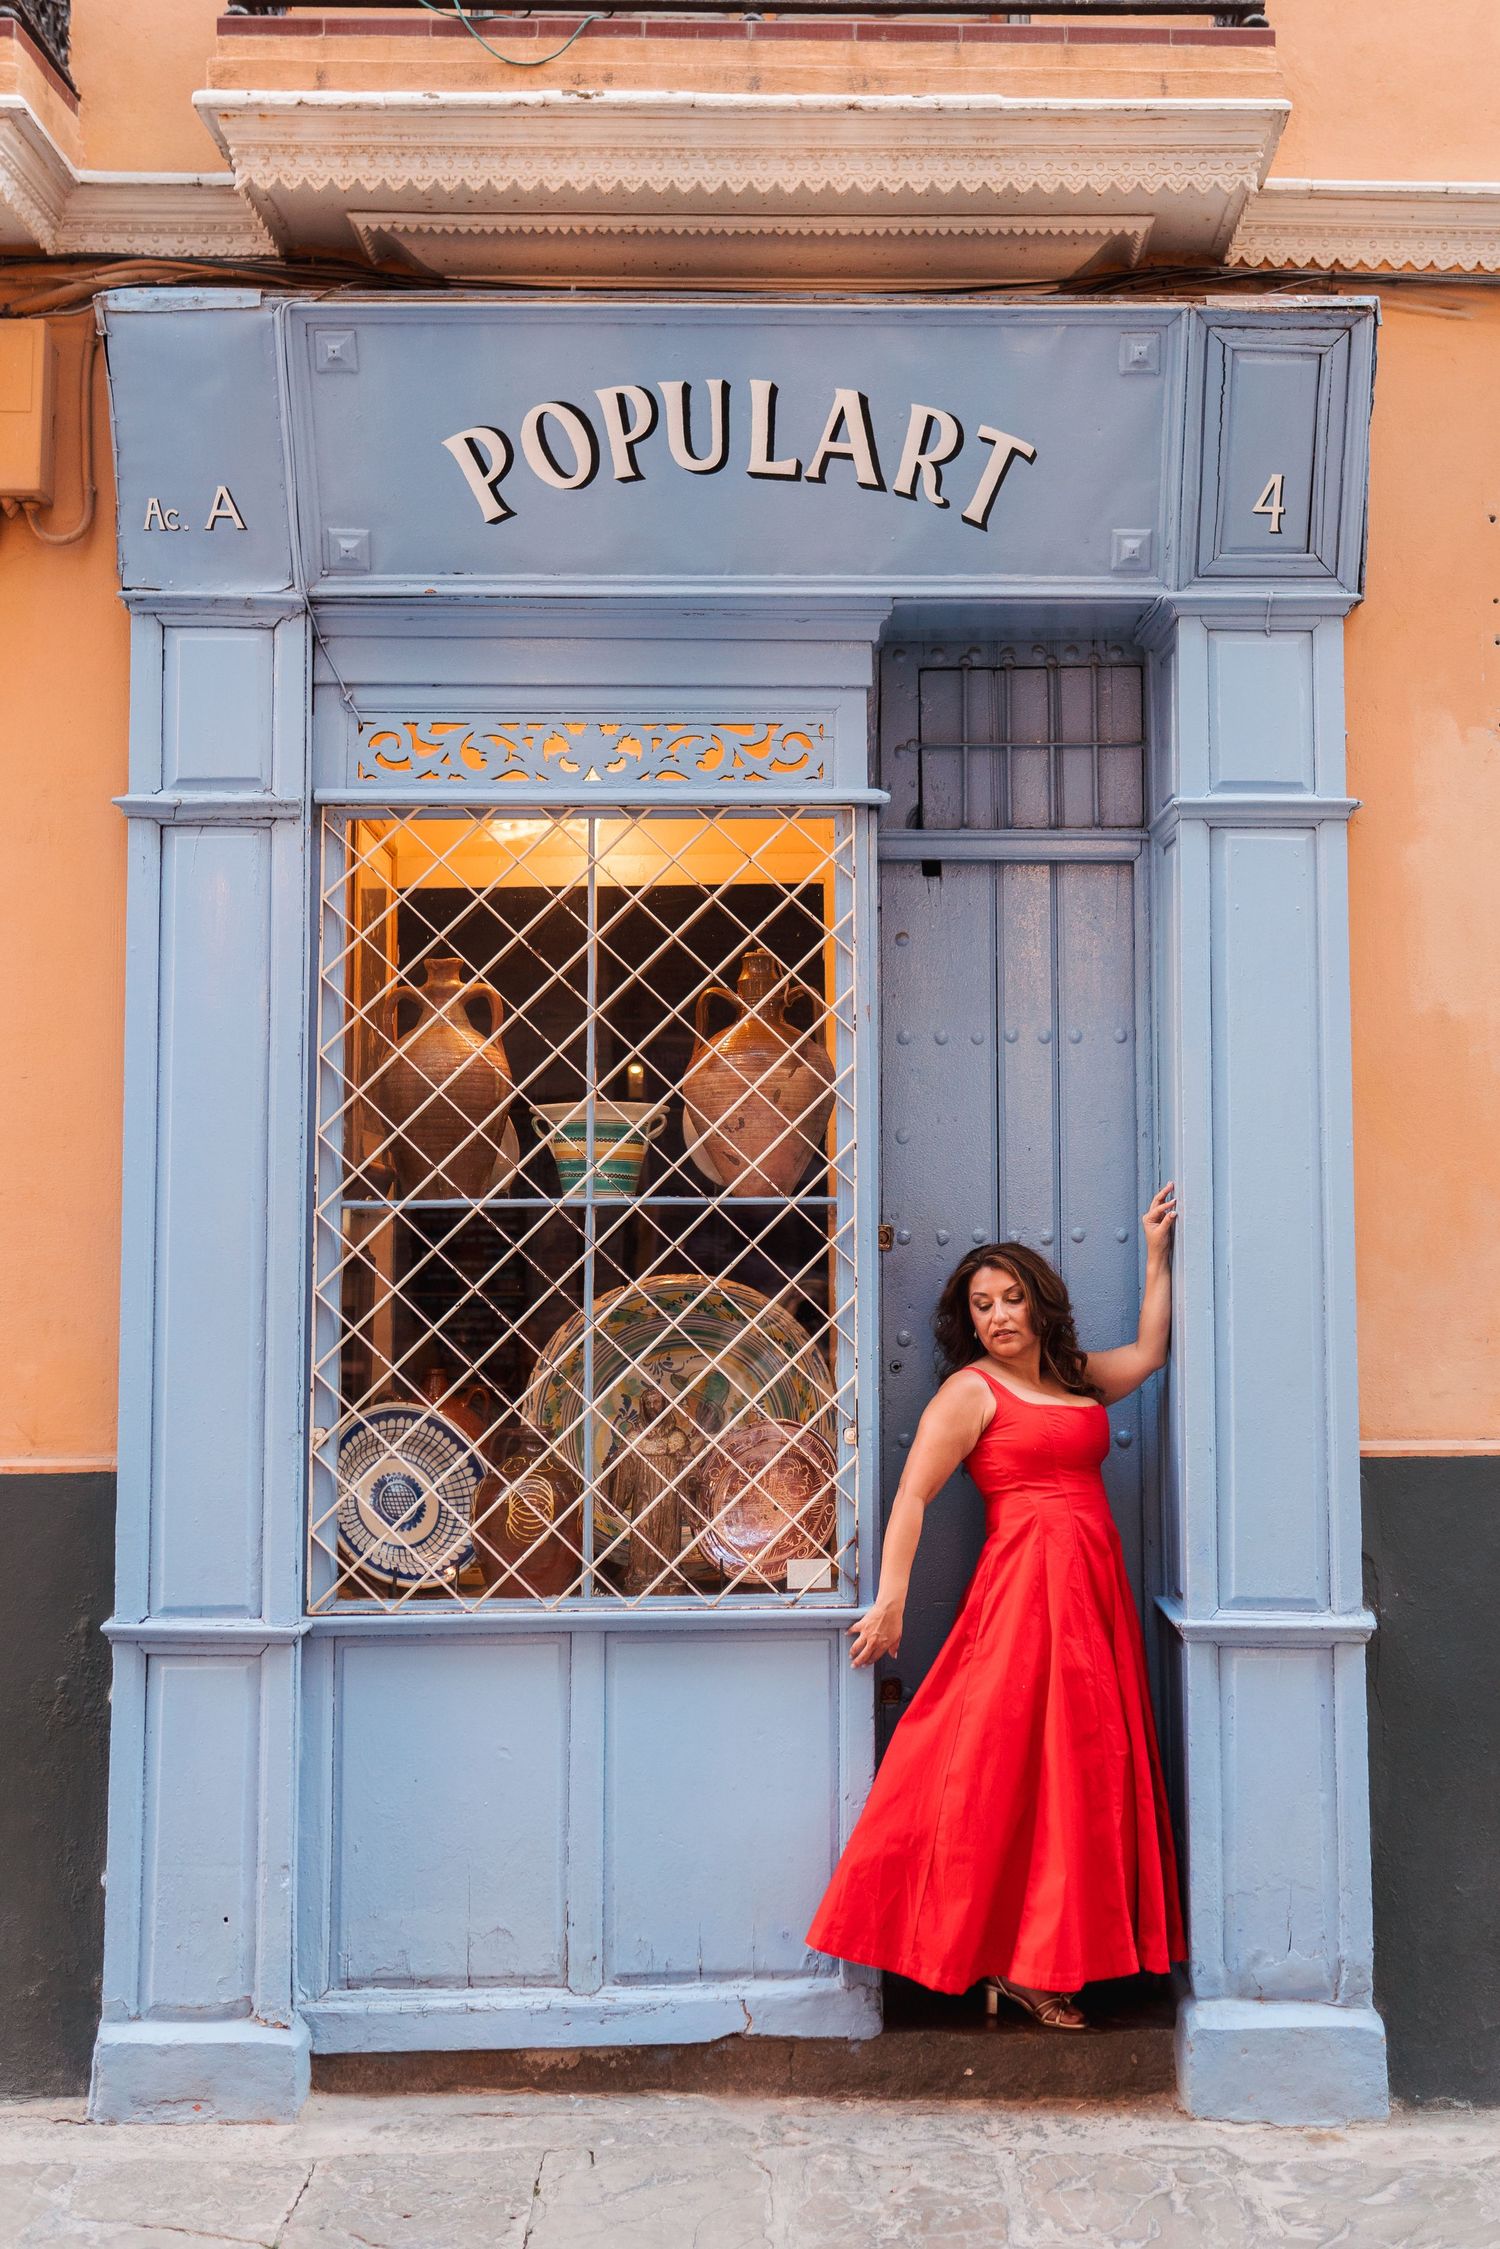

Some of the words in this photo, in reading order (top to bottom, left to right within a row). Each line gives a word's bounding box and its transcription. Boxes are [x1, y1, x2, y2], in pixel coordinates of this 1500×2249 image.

[441, 379, 1038, 531] POPULART
[143, 497, 190, 531] Ac.
[204, 485, 248, 531] A
[1251, 473, 1286, 534] 4
